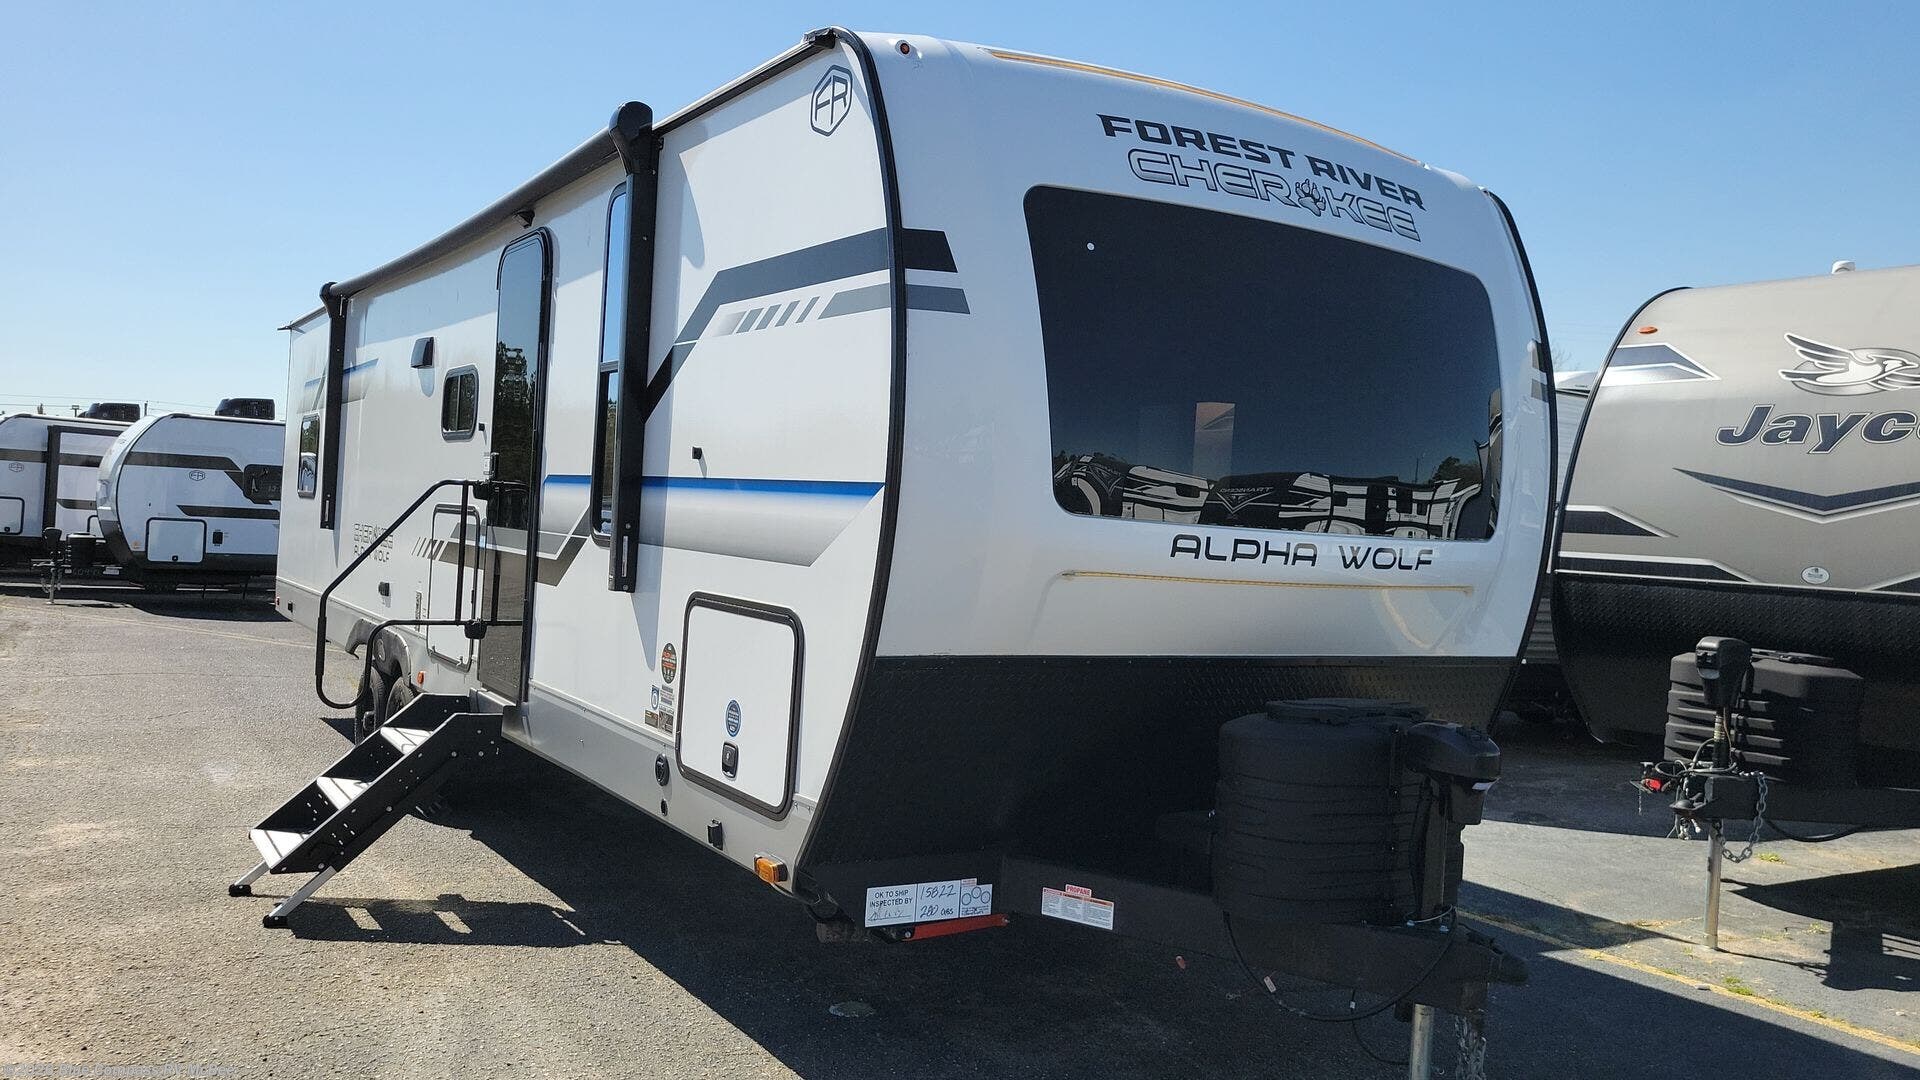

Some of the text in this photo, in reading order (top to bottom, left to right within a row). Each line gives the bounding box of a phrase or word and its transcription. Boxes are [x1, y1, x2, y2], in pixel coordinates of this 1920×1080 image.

[1096, 113, 1427, 211] FOREST RIVER
[1715, 403, 1920, 455] Jayc
[1170, 533, 1433, 571] ALPHA WOLF
[869, 897, 912, 908] INSPECTED BY
[874, 891, 884, 899] OK
[895, 889, 909, 897] SHIP
[1066, 885, 1090, 896] PROPANE
